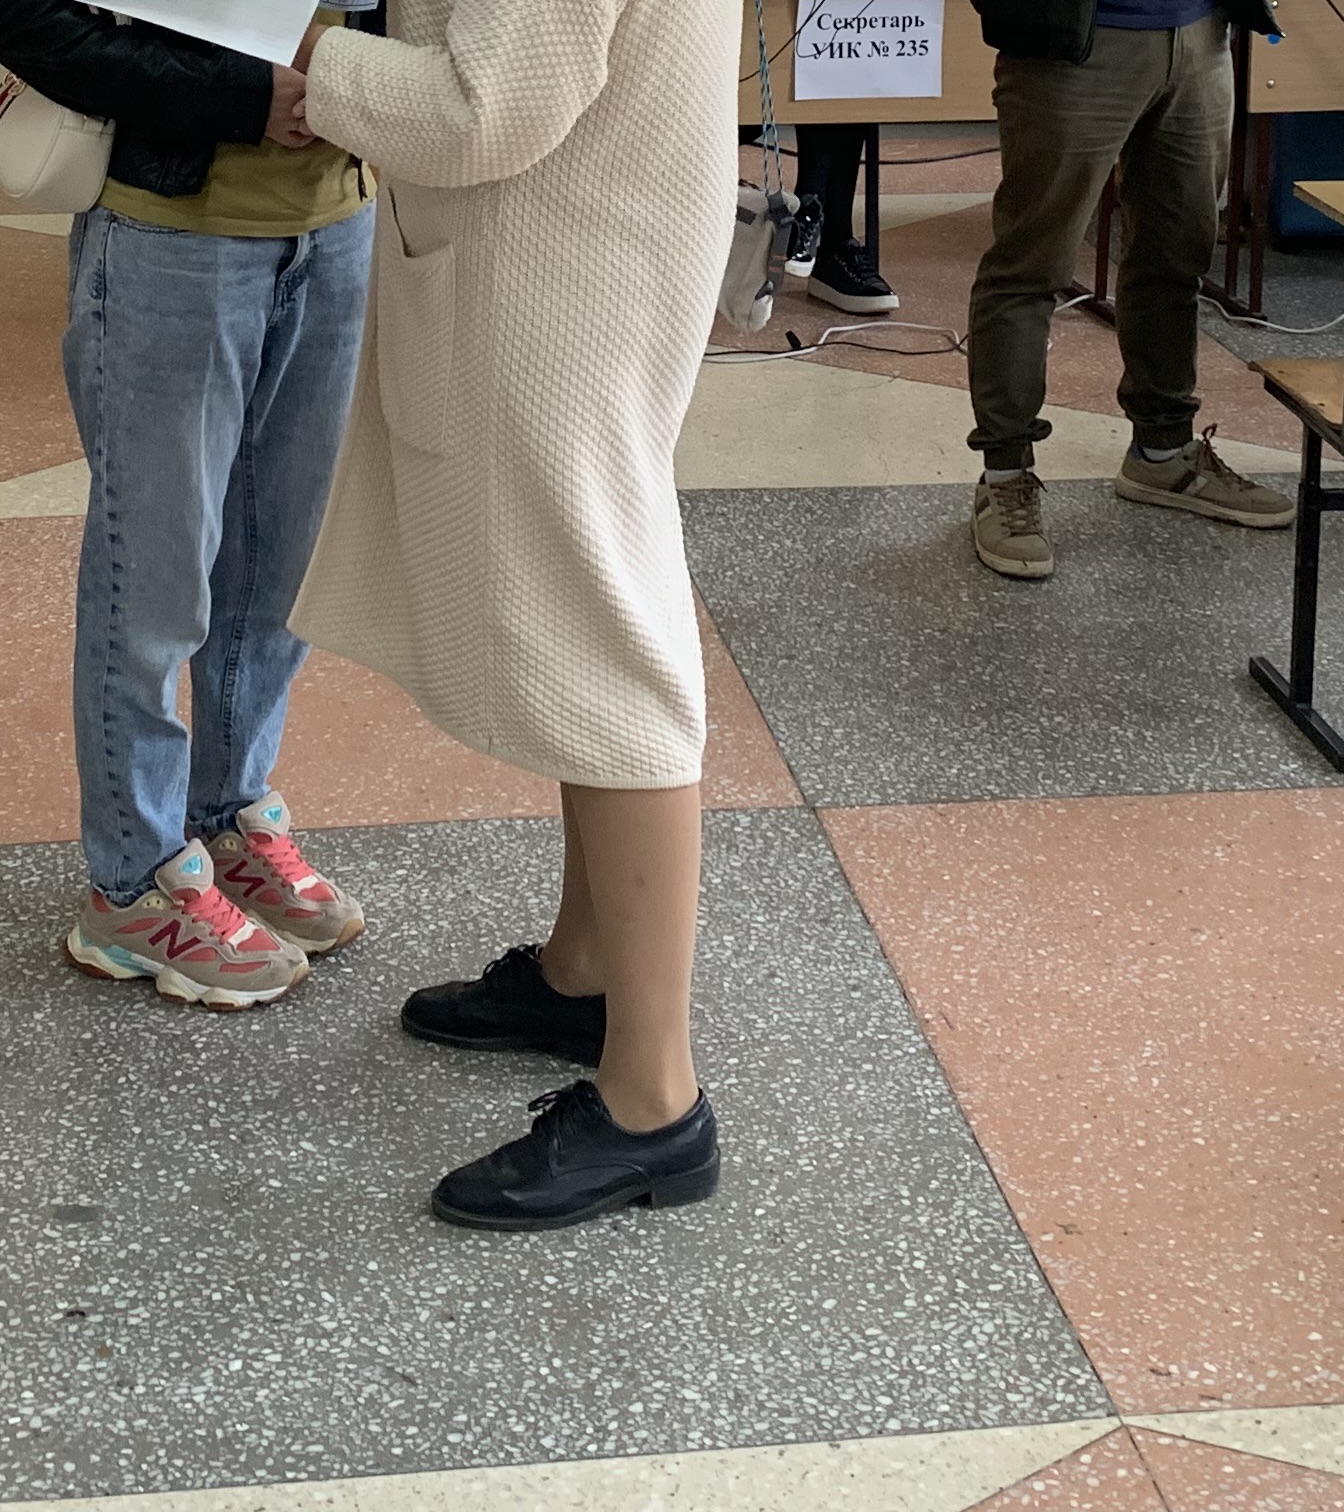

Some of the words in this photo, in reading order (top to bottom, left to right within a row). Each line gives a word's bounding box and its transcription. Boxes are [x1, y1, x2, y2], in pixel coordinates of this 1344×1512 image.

[816, 12, 925, 34] Секретарь
[812, 41, 862, 60] УИК
[867, 40, 890, 58] №
[896, 39, 929, 57] 235
